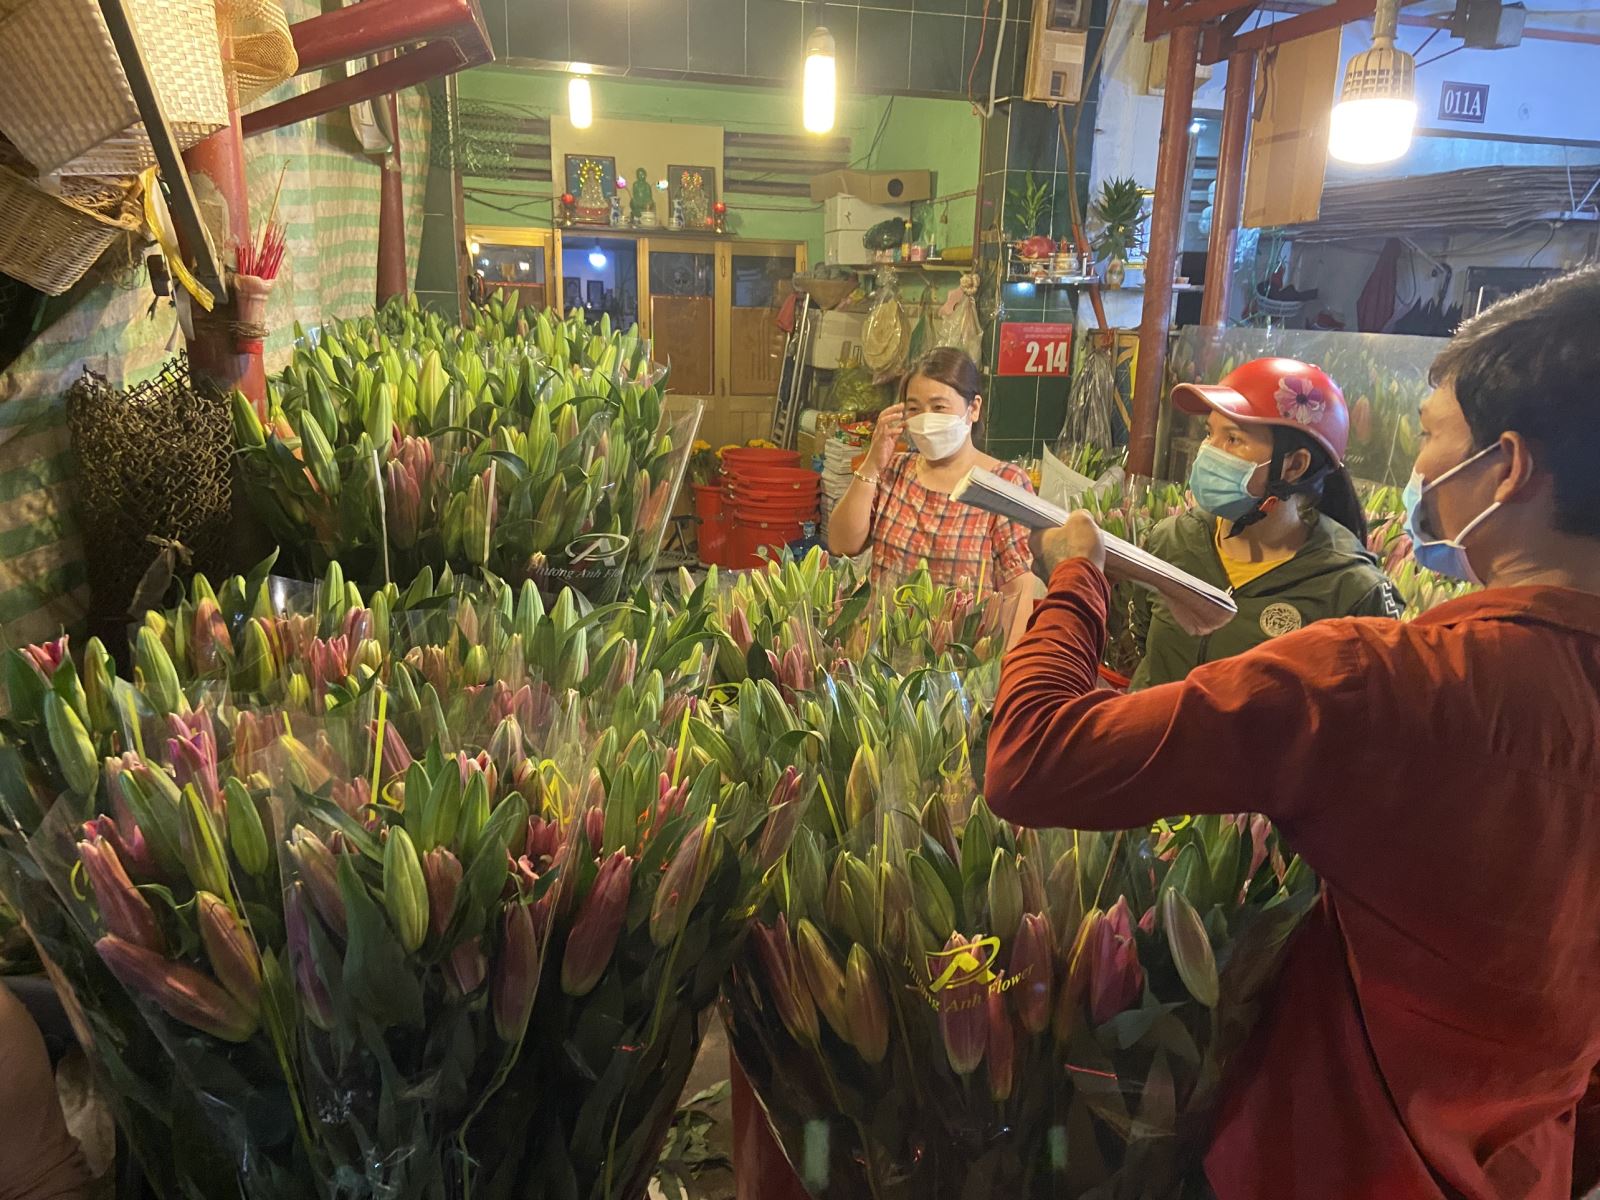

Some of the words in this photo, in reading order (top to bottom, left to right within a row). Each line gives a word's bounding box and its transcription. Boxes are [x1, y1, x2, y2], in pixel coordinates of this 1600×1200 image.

[1444, 89, 1482, 116] 011A
[1024, 340, 1068, 373] 2.14
[576, 568, 601, 579] Anh
[944, 993, 983, 1013] Anh
[988, 963, 1035, 997] Flower
